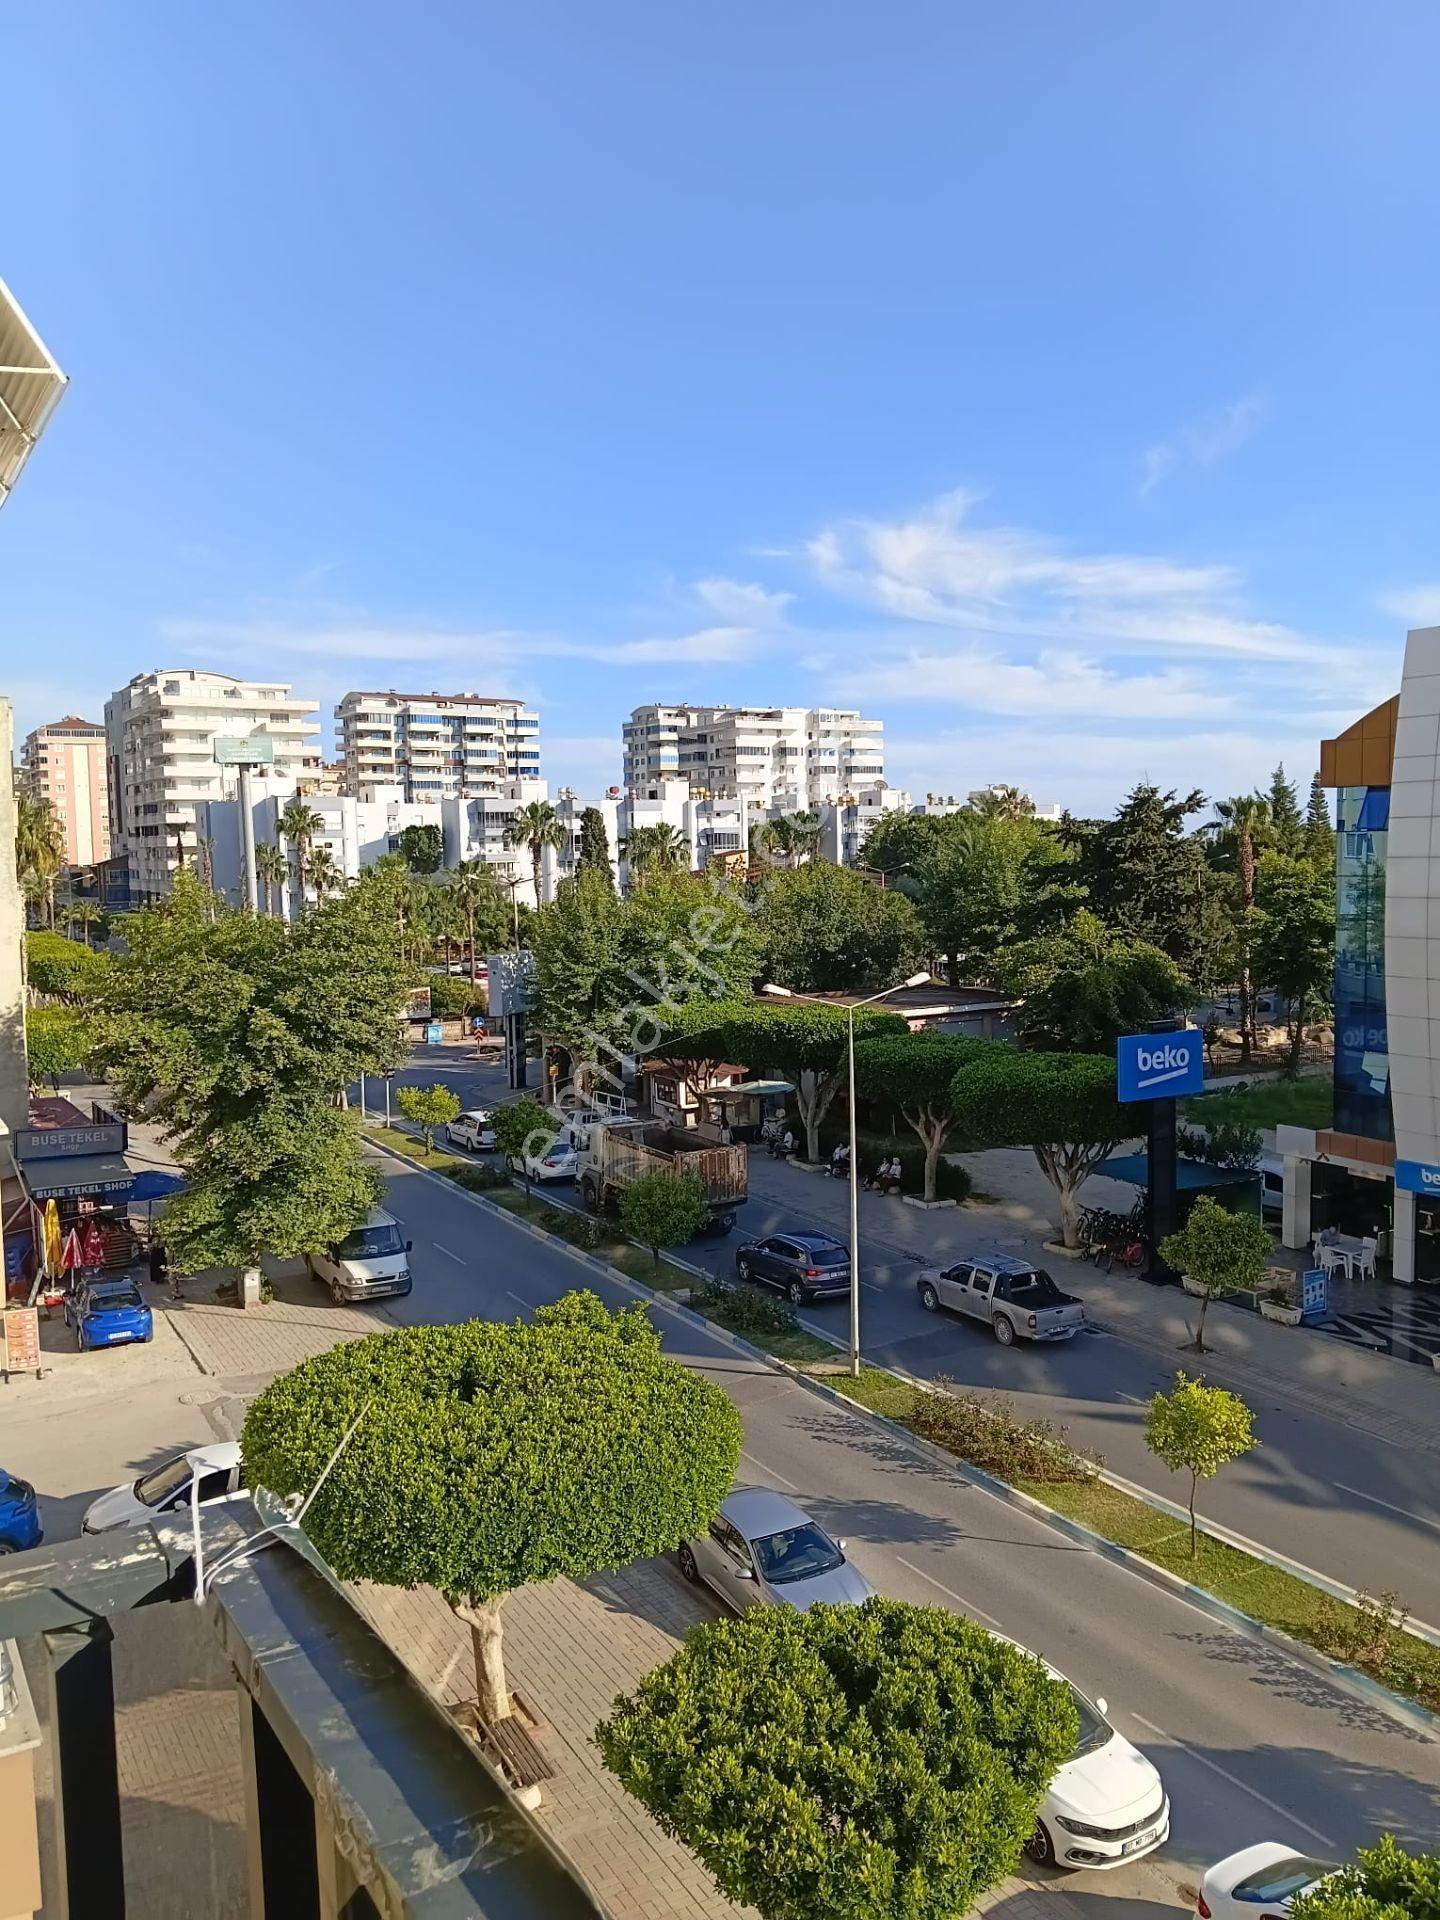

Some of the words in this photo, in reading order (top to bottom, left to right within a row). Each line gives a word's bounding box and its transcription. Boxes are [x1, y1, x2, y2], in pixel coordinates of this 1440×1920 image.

[1138, 1045, 1190, 1071] beko
[32, 1135, 66, 1146] BUSE
[69, 1132, 108, 1143] TEKEL
[36, 1189, 65, 1199] BUSE
[68, 1184, 101, 1195] TEKEL
[104, 1181, 133, 1191] SHOP
